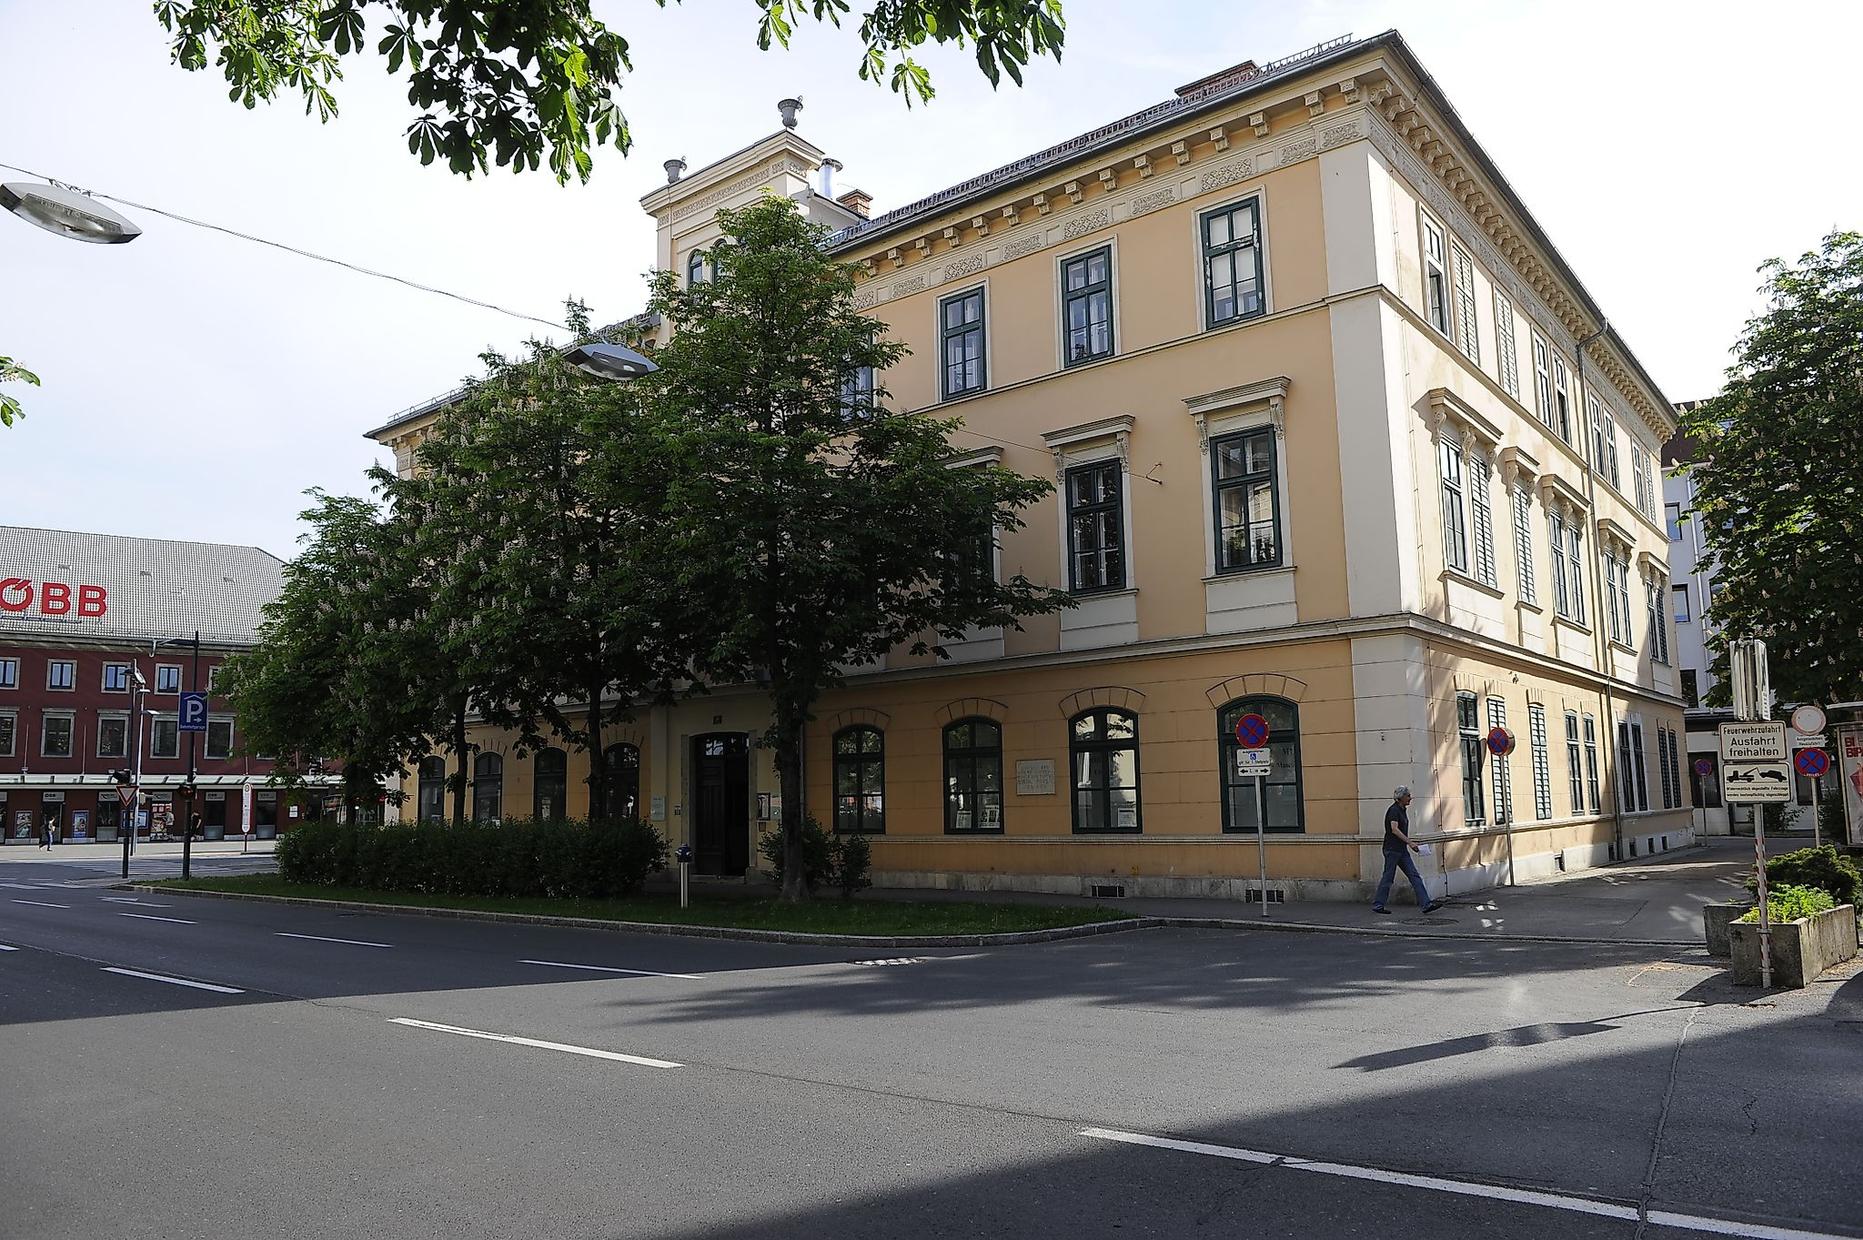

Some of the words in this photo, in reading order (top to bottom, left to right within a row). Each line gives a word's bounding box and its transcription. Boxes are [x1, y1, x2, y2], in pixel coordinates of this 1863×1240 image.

[186, 700, 204, 723] P
[1723, 726, 1781, 735] Feuerwehrzufahrt
[1731, 736, 1776, 746] Ausfahrt
[1729, 747, 1779, 757] freihalten
